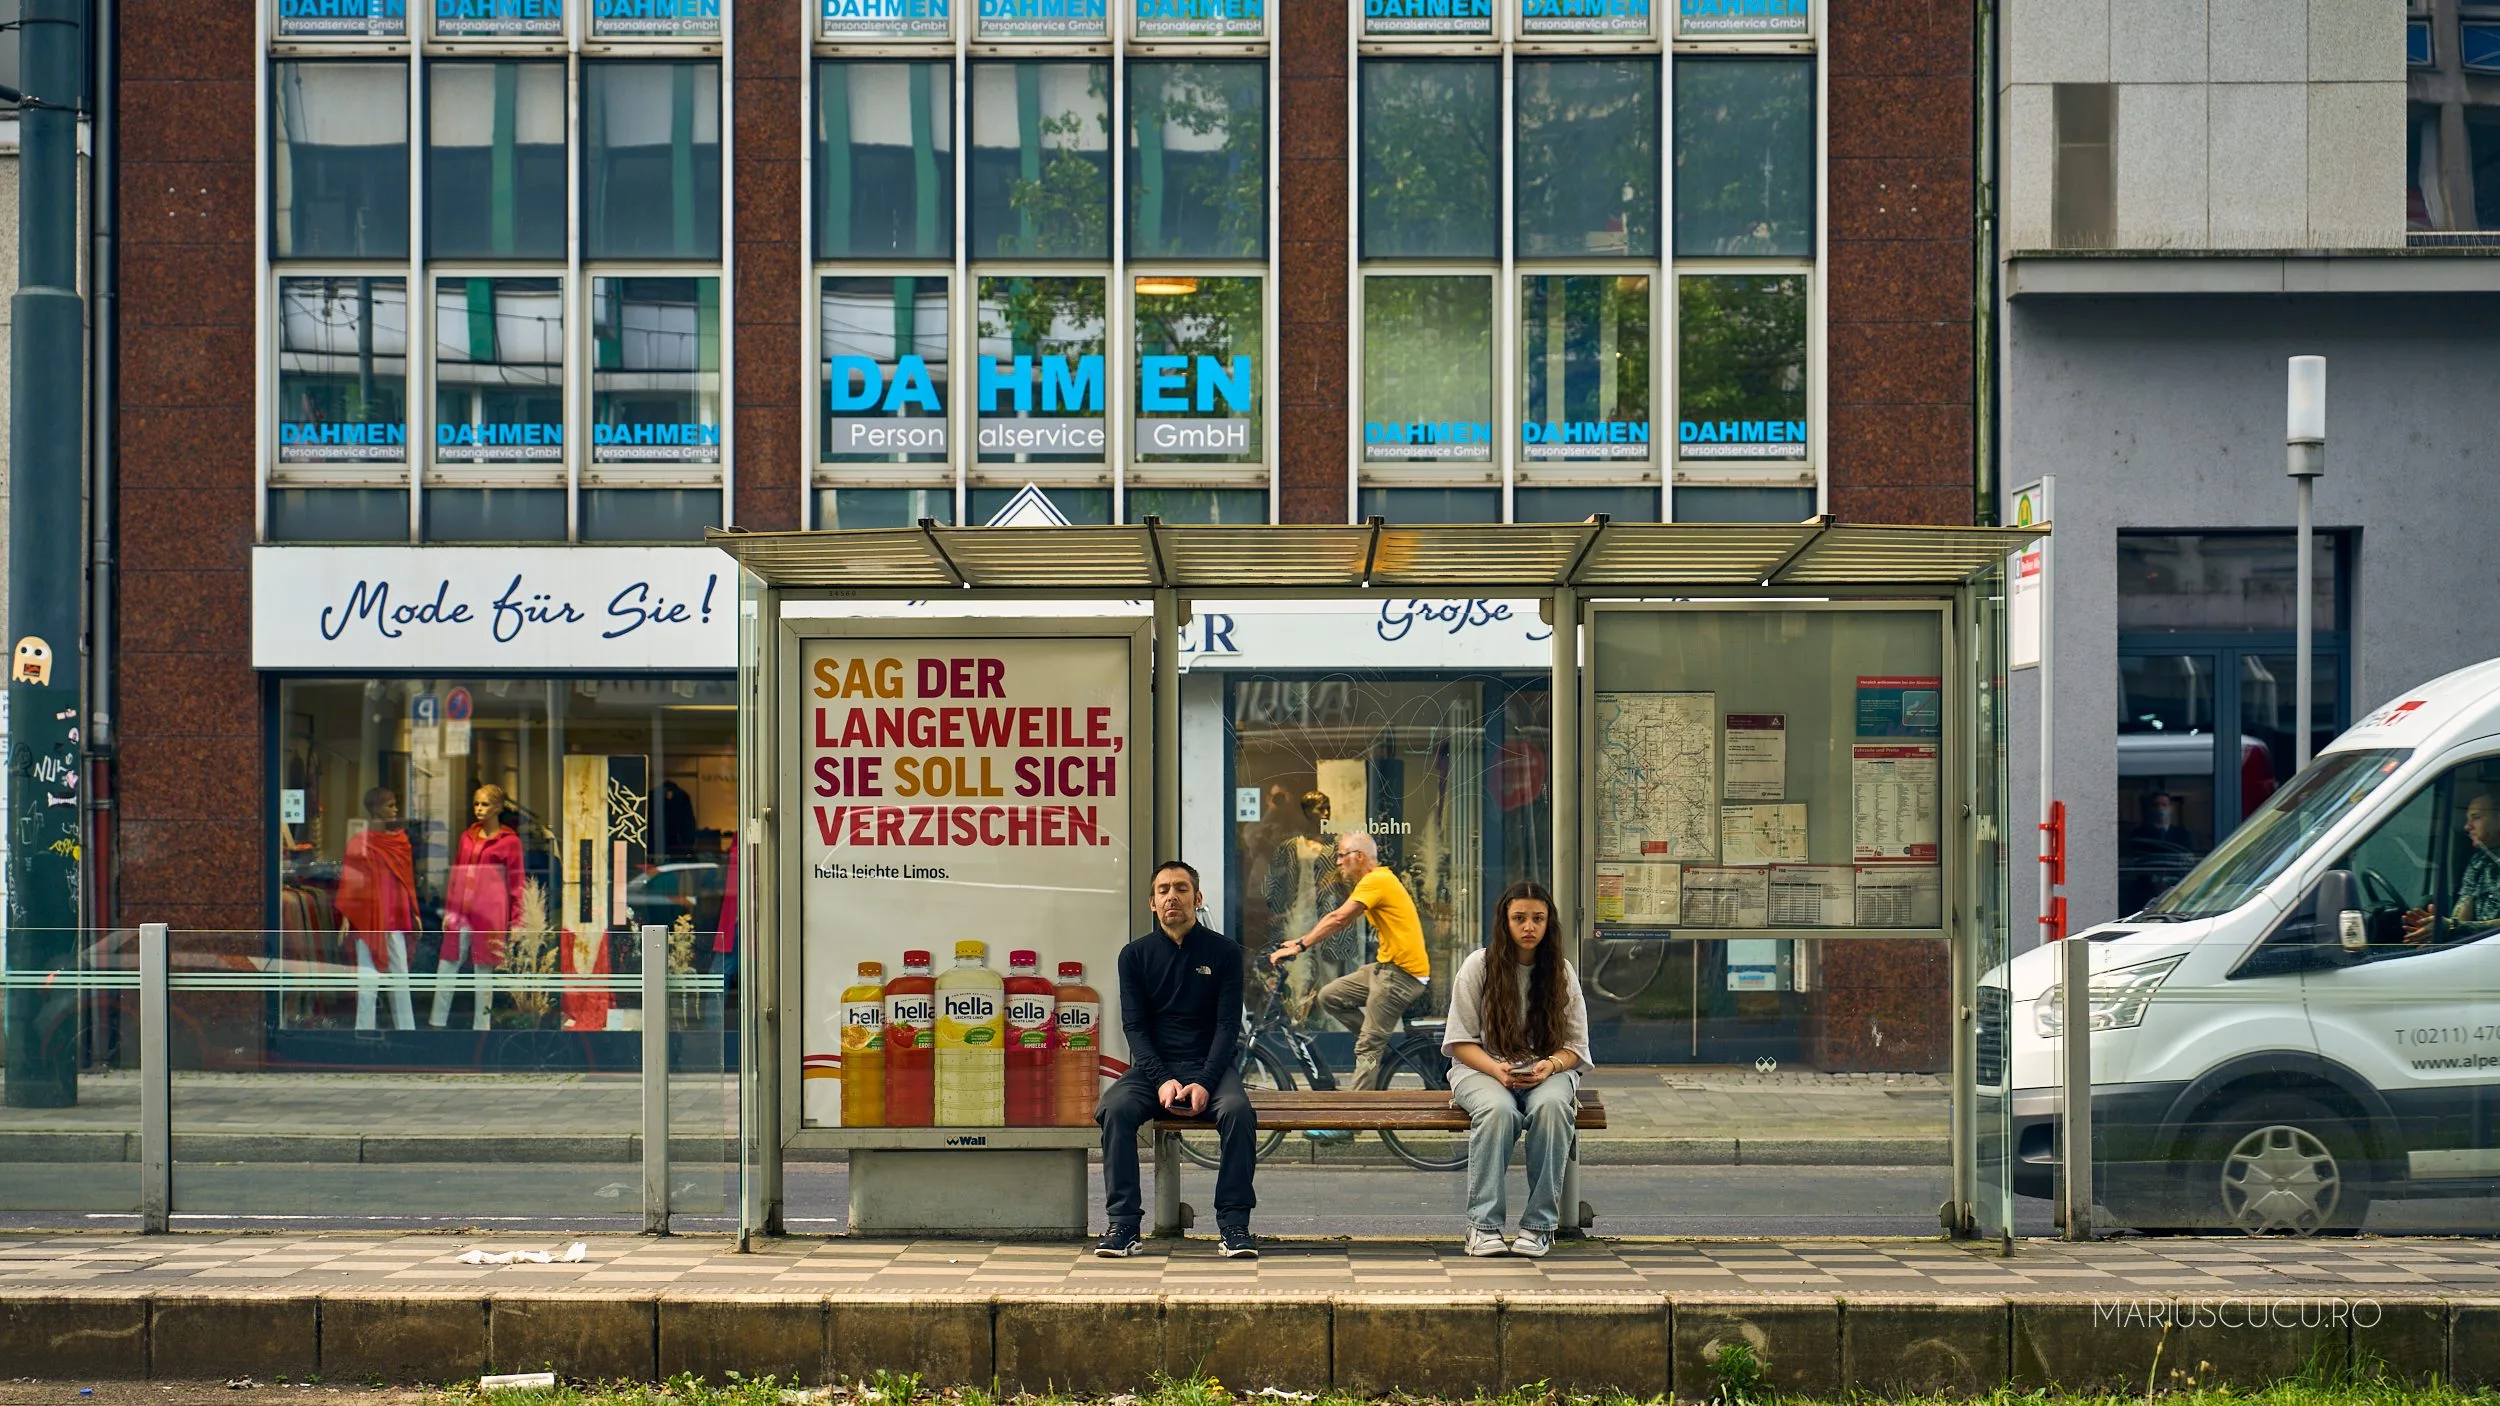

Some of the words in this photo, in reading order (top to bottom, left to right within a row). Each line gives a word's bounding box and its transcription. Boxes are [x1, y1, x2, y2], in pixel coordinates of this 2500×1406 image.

[281, 0, 404, 16] DAHMEN
[438, 0, 562, 17] DAHMEN
[595, 0, 719, 17] DAHMEN
[823, 0, 948, 17] DAHMEN
[980, 0, 1105, 17] DAHMEN
[1137, 0, 1263, 17] DAHMEN
[1366, 0, 1491, 16] DAHMEN
[1523, 0, 1648, 16] DAHMEN
[1681, 0, 1806, 16] DAHMEN
[281, 18, 365, 30] Personalservice
[368, 18, 403, 30] GmbH
[438, 20, 522, 31] Personalservice
[525, 20, 560, 31] GmbH
[596, 20, 680, 31] Personalservice
[682, 20, 718, 31] GmbH
[824, 20, 908, 32] Personalservice
[911, 20, 946, 32] GmbH
[981, 20, 1065, 31] Personalservice
[1068, 20, 1104, 31] GmbH
[1139, 20, 1223, 31] Personalservice
[1226, 20, 1262, 31] GmbH
[1366, 18, 1451, 30] Personalservice
[1454, 18, 1489, 30] GmbH
[1524, 18, 1609, 30] Personalservice
[1612, 18, 1646, 30] GmbH
[1684, 18, 1768, 30] Personalservice
[1770, 18, 1805, 30] GmbH
[281, 424, 406, 444] DAHMEN
[438, 424, 562, 445] DAHMEN
[595, 424, 720, 444] DAHMEN
[1154, 424, 1245, 448] GmbH
[1365, 422, 1491, 443] DAHMEN
[1522, 422, 1648, 443] DAHMEN
[1680, 421, 1806, 443] DAHMEN
[282, 446, 366, 458] Personalservice
[369, 446, 404, 458] GmbH
[438, 447, 522, 458] Personalservice
[526, 447, 560, 458] GmbH
[596, 447, 680, 457] Personalservice
[683, 447, 718, 457] GmbH
[1367, 446, 1451, 456] Personalservice
[1454, 446, 1489, 456] GmbH
[1524, 446, 1608, 456] Personalservice
[1611, 446, 1646, 456] GmbH
[1681, 445, 1765, 455] Personalservice
[1768, 445, 1804, 455] GmbH
[321, 579, 474, 641] Mode
[493, 574, 585, 643] für
[813, 658, 904, 699] SAG
[917, 658, 1007, 699] DER
[815, 707, 1124, 753] LANGEWEILE,
[813, 756, 883, 797] SIE
[894, 756, 1004, 797] SOLL
[1014, 756, 1116, 797] SICH
[813, 805, 1110, 846] VERZISCHEN.
[1320, 818, 1411, 835] Rbahn
[814, 864, 848, 879] hella
[852, 864, 900, 879] leichte
[903, 864, 950, 879] Limos.
[945, 996, 993, 1015] hella
[1055, 1009, 1090, 1024] ella
[2394, 1029, 2405, 1045] T
[2410, 1026, 2469, 1047] (0211)
[2410, 1053, 2500, 1070] www.alpe
[959, 1136, 986, 1146] Wall
